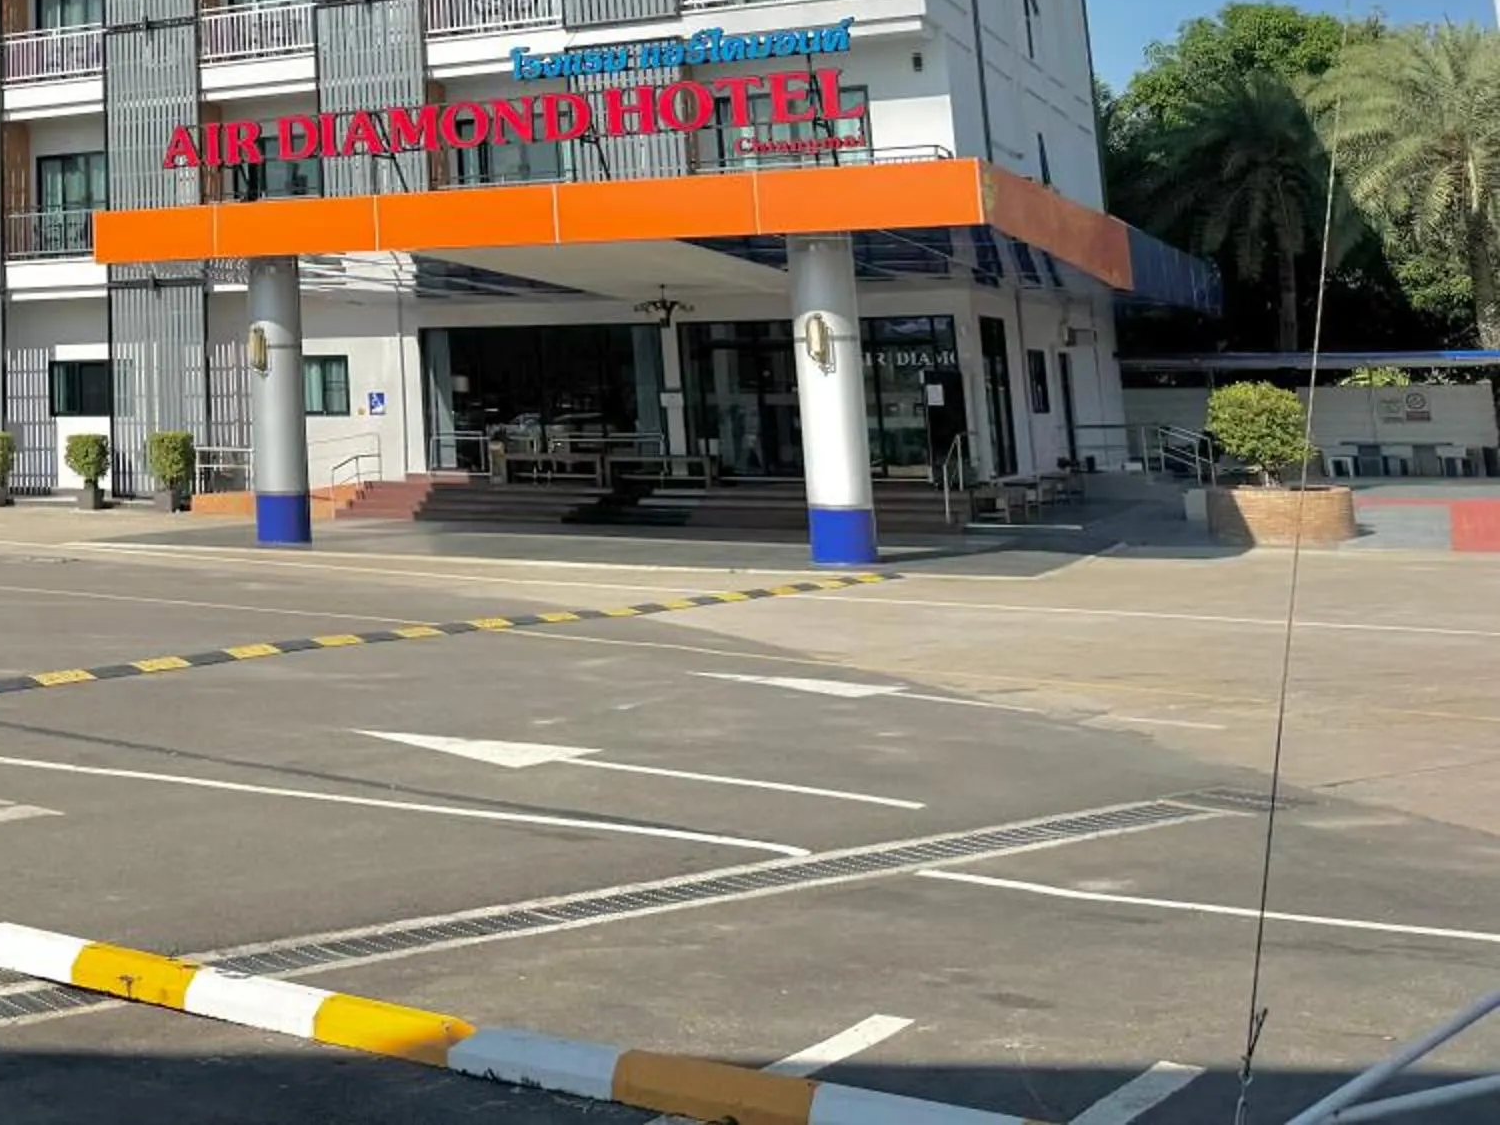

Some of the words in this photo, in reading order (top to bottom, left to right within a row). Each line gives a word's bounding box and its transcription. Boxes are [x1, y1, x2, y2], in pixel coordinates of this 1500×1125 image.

[510, 46, 628, 80] โรงแรม
[163, 119, 265, 169] AIR
[276, 93, 591, 161] DIAMOND
[603, 69, 867, 137] HOTEL
[861, 351, 886, 366] IR
